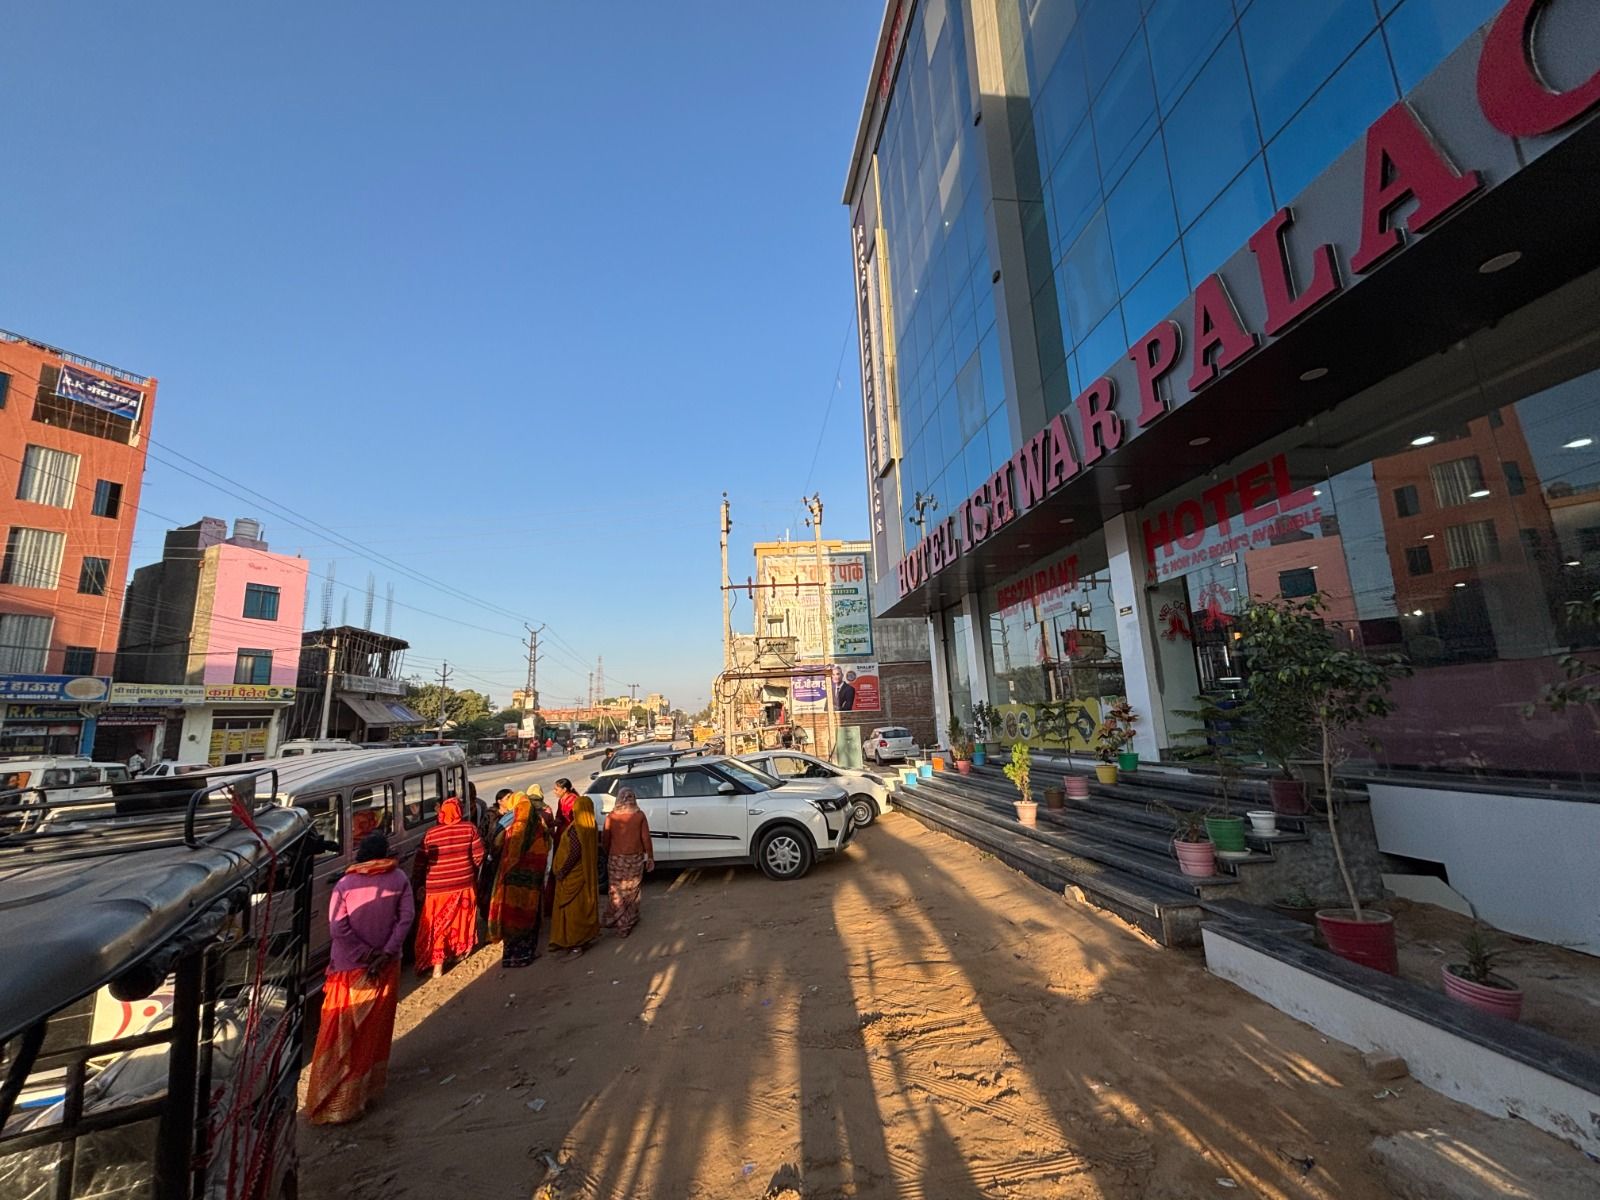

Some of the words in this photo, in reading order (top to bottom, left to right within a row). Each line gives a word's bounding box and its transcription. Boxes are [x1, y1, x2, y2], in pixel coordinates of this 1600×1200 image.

[897, 518, 958, 597] HOTEL
[959, 376, 1126, 553] ISHWAR
[1142, 453, 1317, 564] HOTEL
[1170, 556, 1191, 573] NON
[1251, 507, 1322, 544] AVAILABLE
